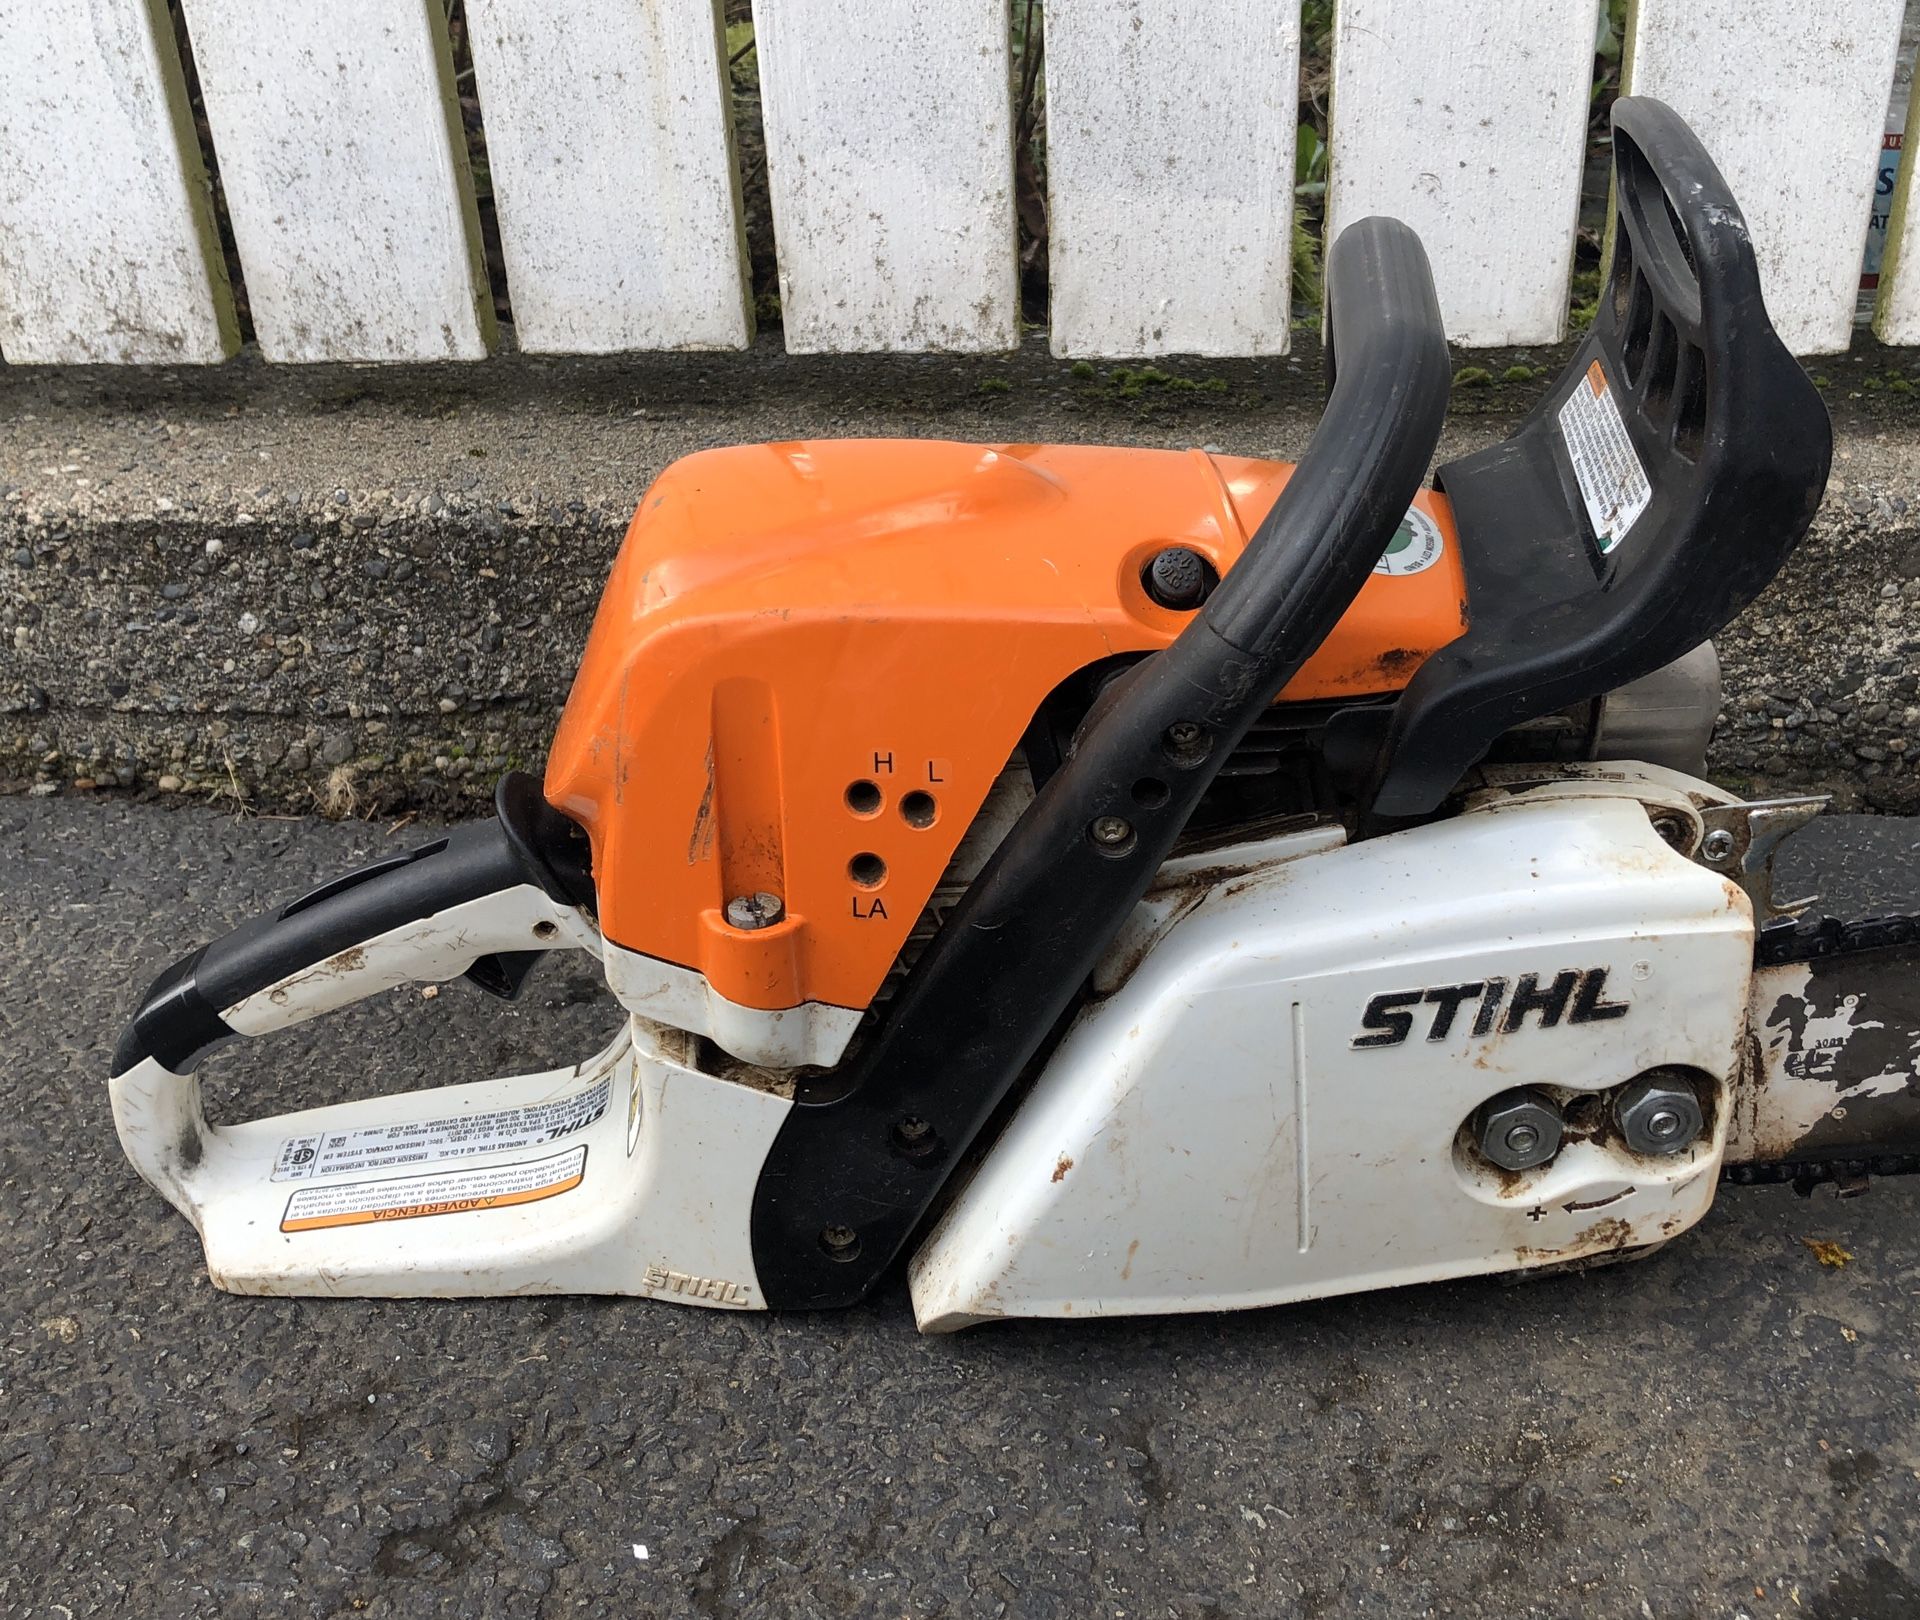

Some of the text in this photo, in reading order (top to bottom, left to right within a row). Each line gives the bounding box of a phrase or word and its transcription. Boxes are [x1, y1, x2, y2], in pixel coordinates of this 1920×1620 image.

[874, 752, 892, 773] H
[928, 761, 944, 782] L
[852, 896, 888, 920] LA
[1349, 964, 1631, 1050] STIHL
[550, 1098, 585, 1114] COMPLIANCE
[475, 1110, 519, 1121] ADJUSTMENTS
[557, 1108, 576, 1119] MEETS
[545, 1103, 607, 1140] STIHL
[366, 1145, 393, 1154] CONTROL
[395, 1141, 425, 1150] EMISSION
[498, 1140, 527, 1149] ANDREAS
[368, 1158, 396, 1166] CONTROL
[397, 1152, 428, 1163] EMISSION
[557, 1157, 571, 1166] uso
[320, 1162, 365, 1173] INFORMATION
[519, 1163, 555, 1175] indebido
[550, 1161, 580, 1176] manual
[564, 1168, 580, 1178] Lea
[489, 1170, 517, 1179] puede
[377, 1182, 425, 1192] personales
[428, 1179, 454, 1188] daños
[506, 1183, 532, 1192] todas
[535, 1178, 553, 1187] siga
[425, 1189, 488, 1203] precauciones
[426, 1188, 446, 1196] está
[349, 1192, 400, 1205] disposición
[361, 1199, 407, 1210] seguridad
[373, 1198, 480, 1219] ADVERTENCIA
[317, 1206, 358, 1215] incluidas
[642, 1266, 748, 1306] STIHL
